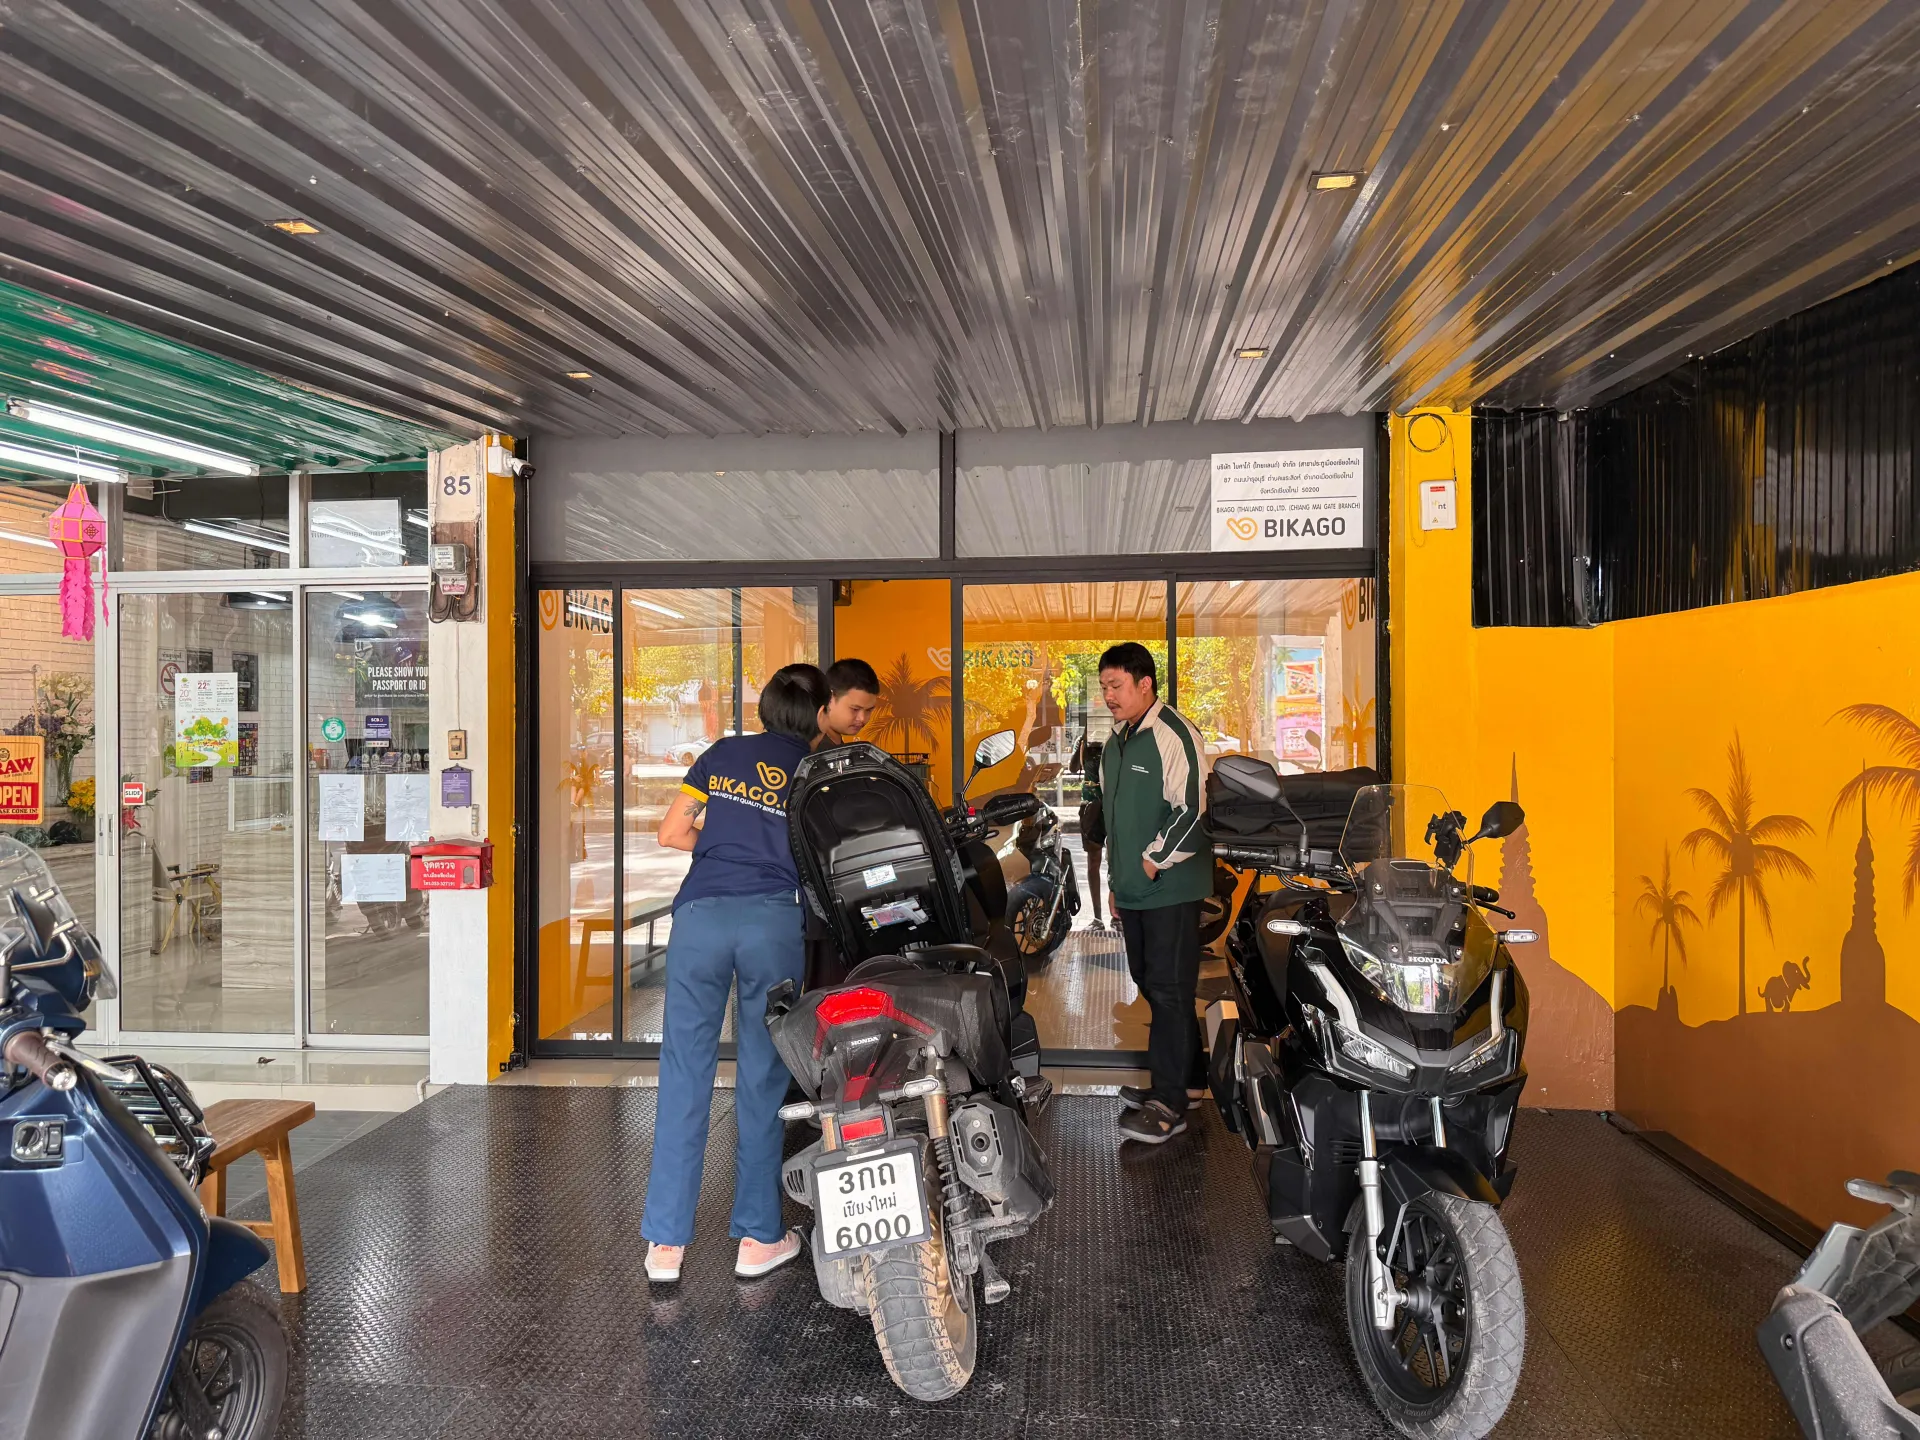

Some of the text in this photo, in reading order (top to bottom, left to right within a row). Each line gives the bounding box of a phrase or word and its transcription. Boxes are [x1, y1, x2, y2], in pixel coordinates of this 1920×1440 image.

[444, 476, 470, 496] 85
[1264, 517, 1345, 538] BIKAGO
[563, 590, 613, 633] BIKAG
[368, 666, 392, 677] PLEASE
[394, 666, 414, 677] SHOW
[372, 680, 426, 690] PASSPORT OR ID
[0, 786, 31, 806] PEN
[740, 798, 763, 809] QUALITY
[424, 861, 455, 872] จุดตรวจ
[1408, 956, 1449, 964] HONDA
[851, 1036, 879, 1046] HONDA
[839, 1162, 896, 1194] 3กถ
[844, 1192, 896, 1217] เชียงใหม่
[836, 1214, 910, 1250] 6000
